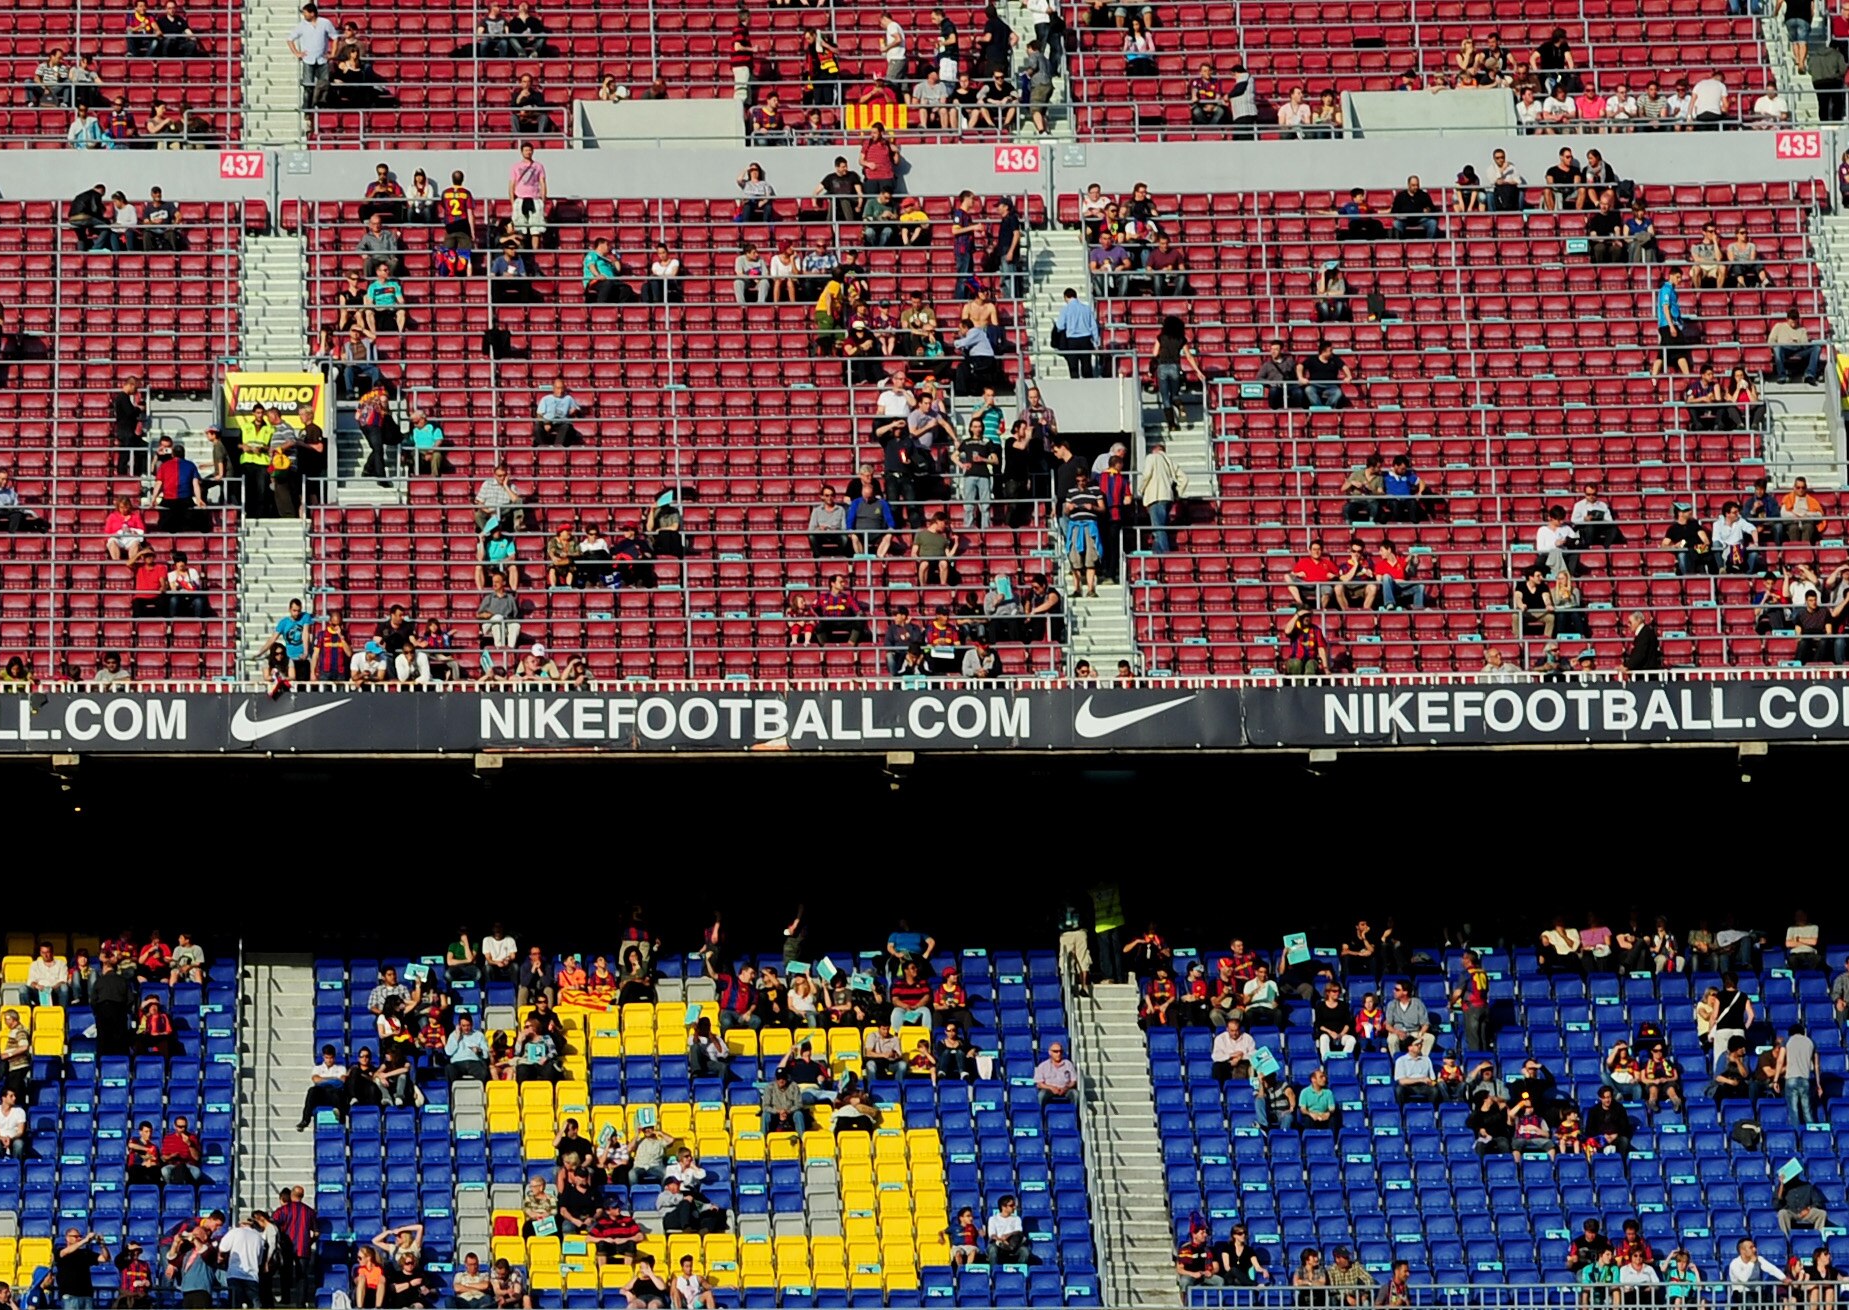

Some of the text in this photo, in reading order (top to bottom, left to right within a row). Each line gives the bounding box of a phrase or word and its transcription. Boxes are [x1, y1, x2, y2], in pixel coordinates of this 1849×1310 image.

[1778, 134, 1818, 156] 435
[221, 155, 261, 176] 437
[996, 148, 1037, 170] 436
[449, 198, 463, 216] 2
[237, 386, 314, 403] MUNDO
[479, 696, 1031, 740] NIKEFOOTBALL.COM
[1324, 686, 1849, 735] NIKEFOOTBALL.CO
